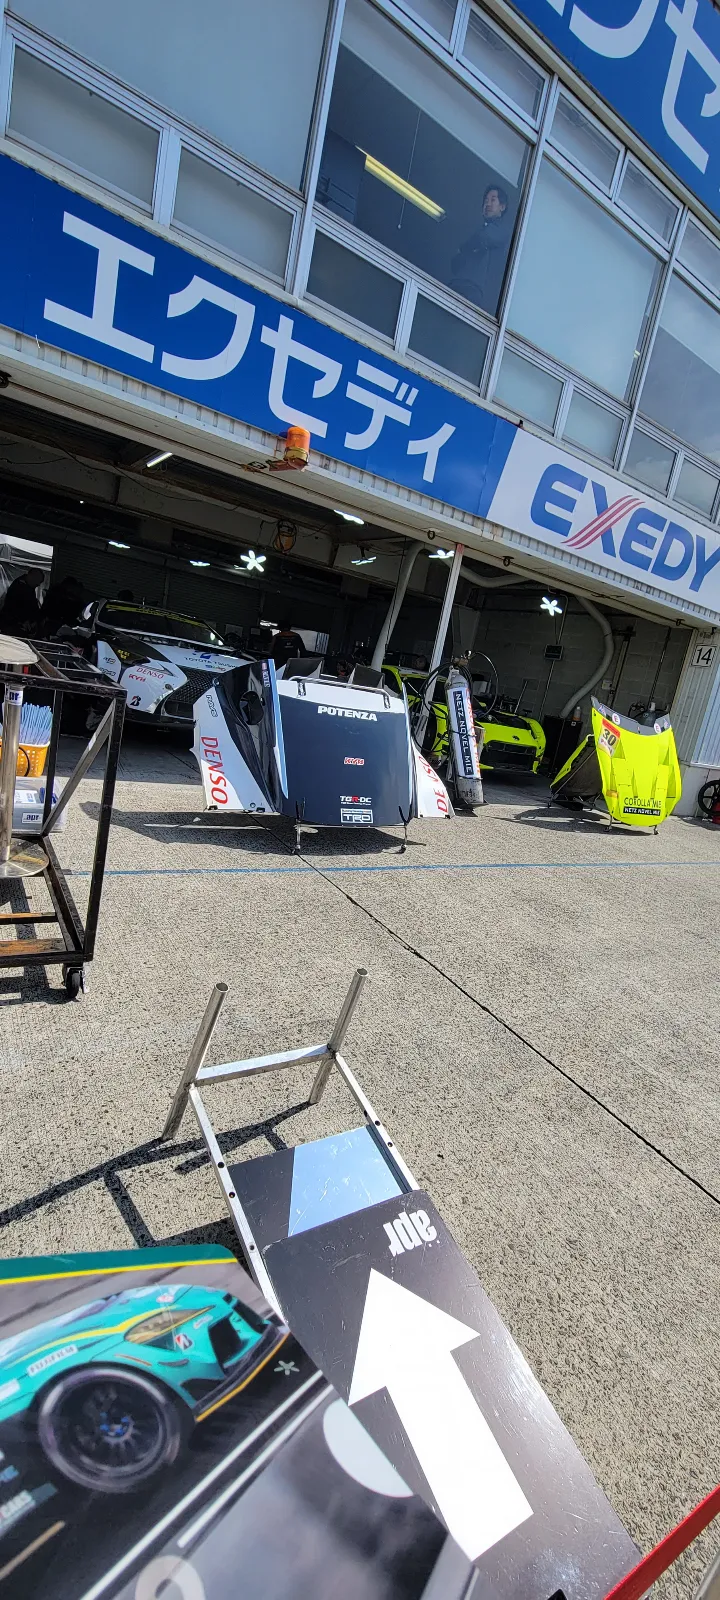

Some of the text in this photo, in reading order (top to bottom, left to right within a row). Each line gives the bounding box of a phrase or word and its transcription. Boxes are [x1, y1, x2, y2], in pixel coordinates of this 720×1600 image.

[43, 211, 456, 483] エクセディ
[530, 463, 720, 593] EXEDY
[696, 646, 712, 665] 14
[137, 667, 164, 679] DENSO
[317, 705, 378, 722] POTENZA
[455, 693, 464, 718] NETZ
[459, 721, 469, 752] NOVEL
[602, 728, 617, 746] 30
[200, 736, 228, 805] DENSO
[464, 755, 474, 773] MIE
[340, 795, 372, 803] TGR-DC
[623, 796, 651, 807] COROLLA
[26, 814, 40, 822] apr
[343, 813, 371, 824] TRD
[382, 1209, 438, 1258] apr
